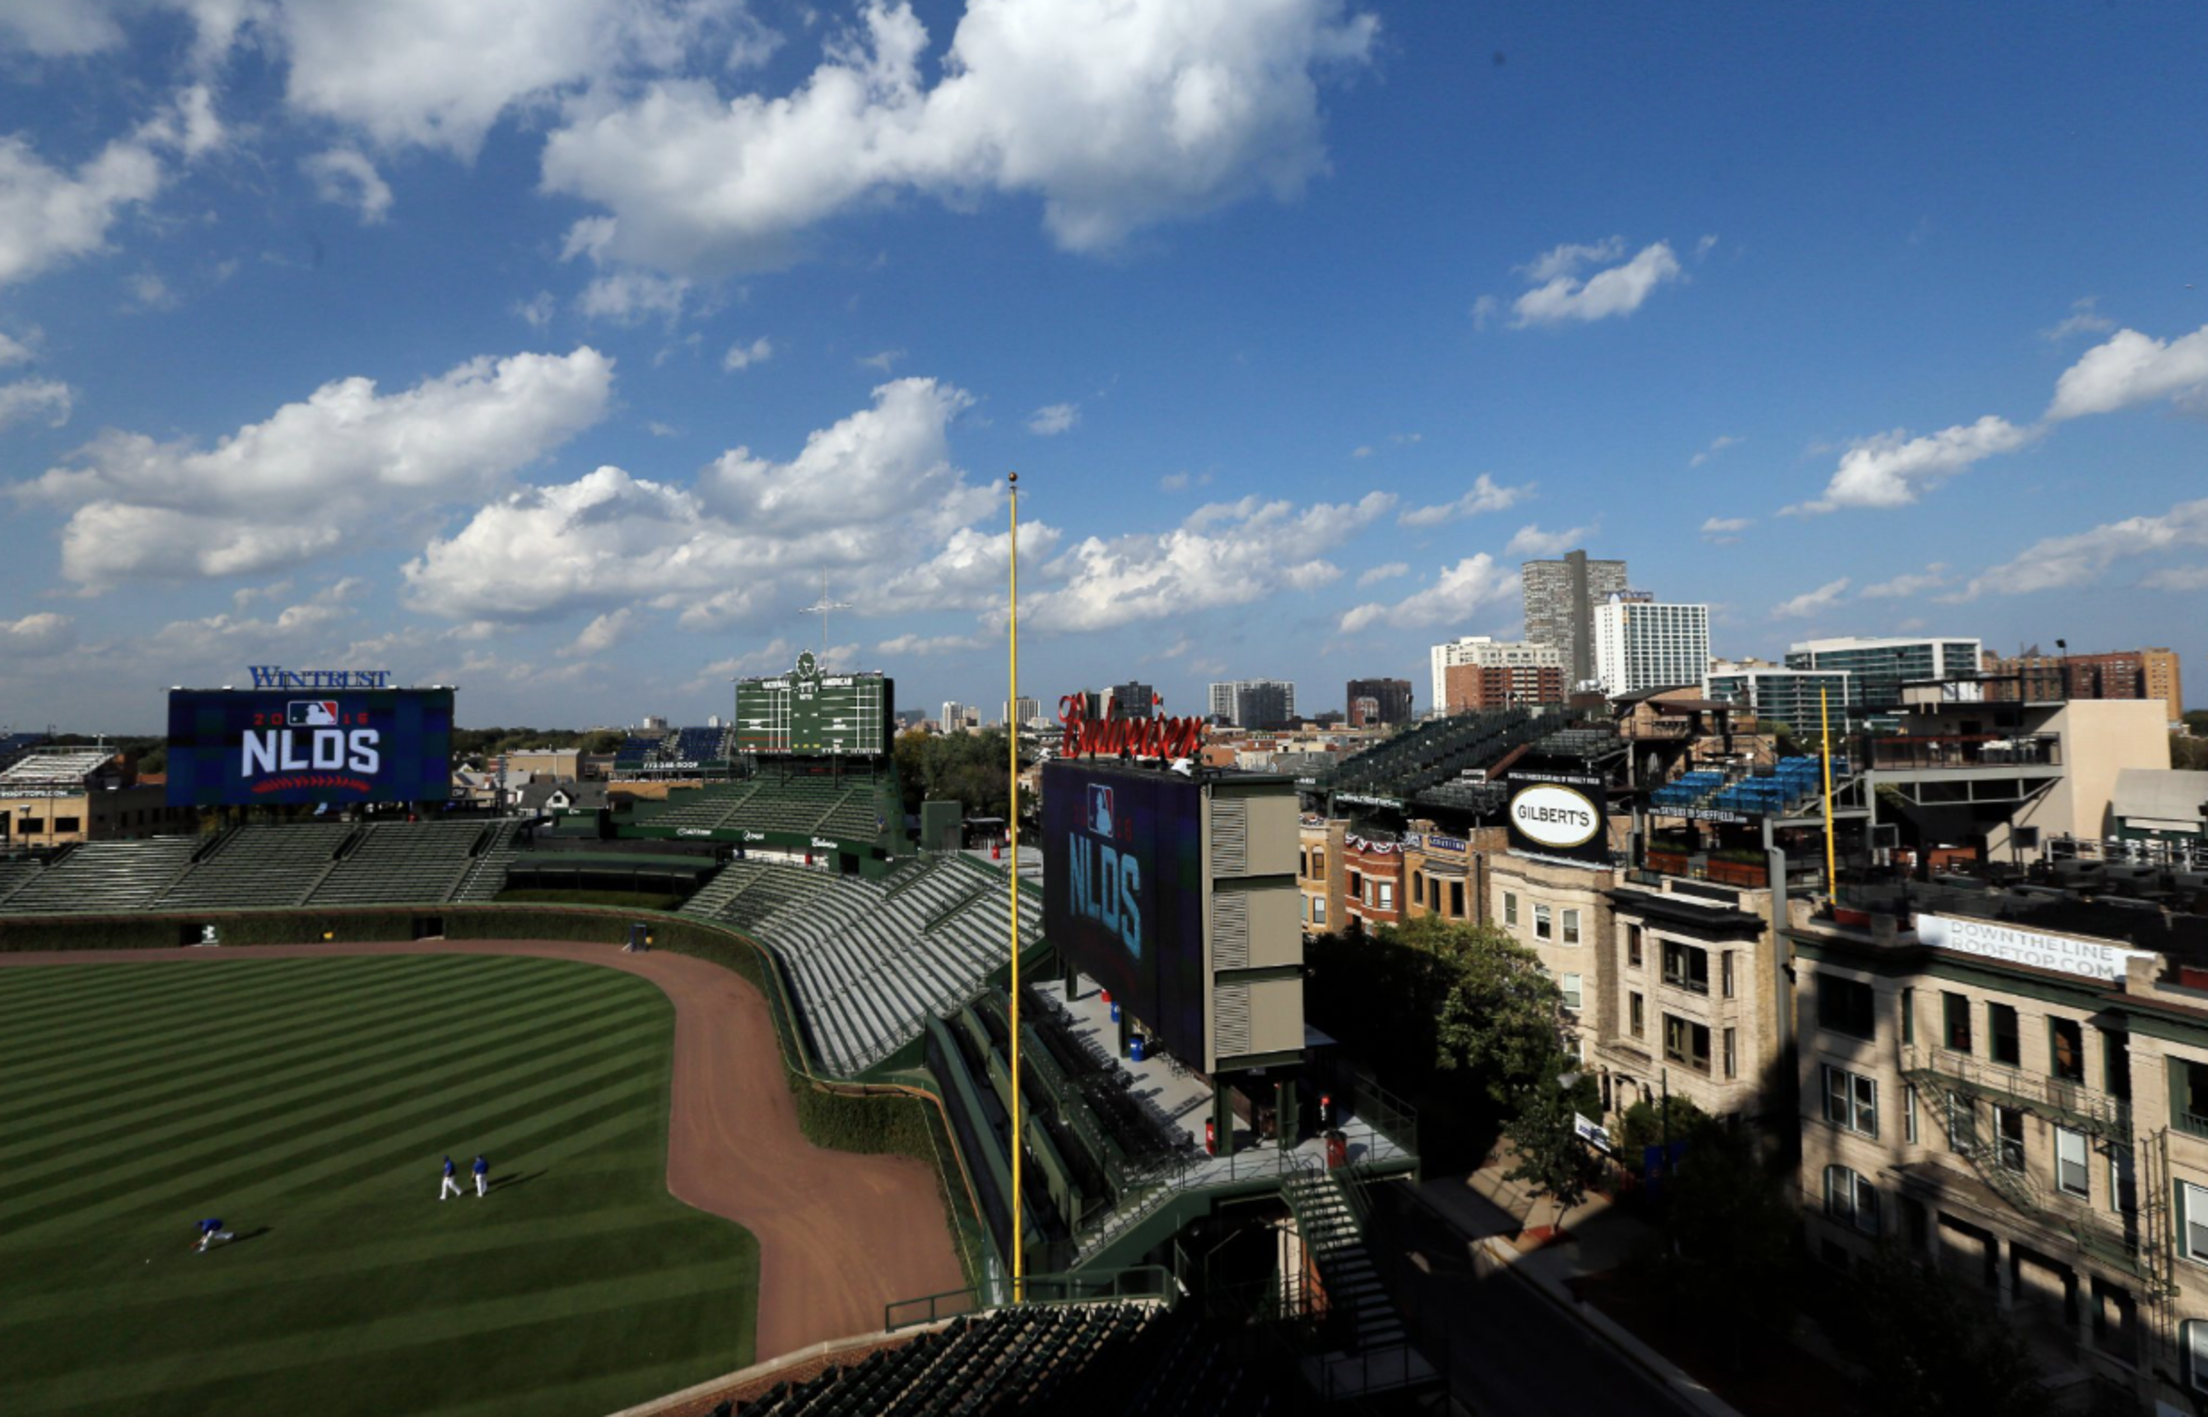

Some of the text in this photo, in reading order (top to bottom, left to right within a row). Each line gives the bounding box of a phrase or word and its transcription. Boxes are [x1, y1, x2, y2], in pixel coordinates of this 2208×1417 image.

[247, 665, 391, 688] WINTRUST
[1058, 692, 1205, 759] Budweiser
[241, 729, 380, 778] NLDS
[1517, 804, 1590, 828] GILBERT'S
[1069, 831, 1142, 961] NLDS
[1951, 922, 2114, 962] DOWN THE LINE
[1951, 937, 2115, 979] ROOFTOP.COM
